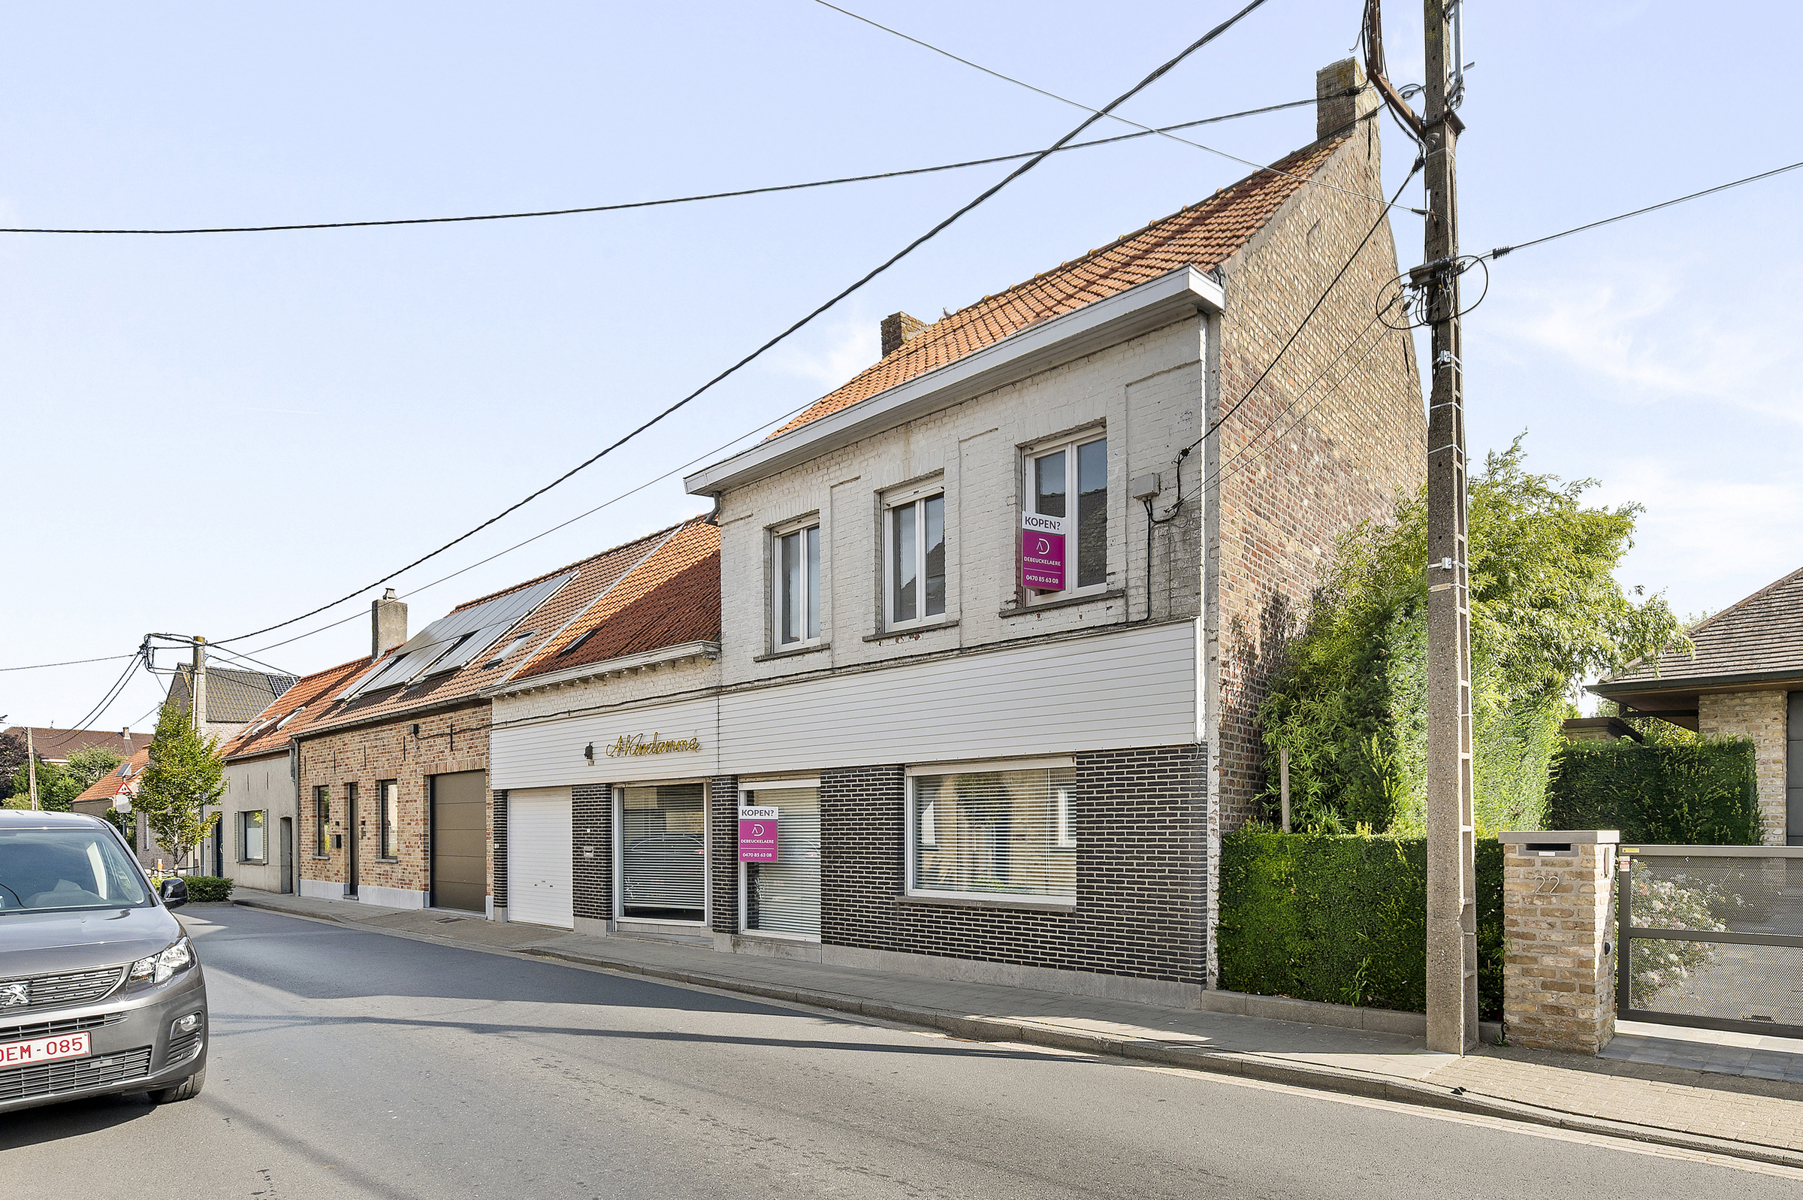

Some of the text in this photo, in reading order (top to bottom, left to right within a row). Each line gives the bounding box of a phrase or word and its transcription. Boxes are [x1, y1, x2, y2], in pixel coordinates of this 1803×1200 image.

[1025, 516, 1061, 530] KOPEN?
[1024, 556, 1061, 566] DEBEUCKELAERE
[1025, 574, 1038, 582] 0470
[741, 809, 774, 817] KOPEN?
[1535, 875, 1560, 896] 22
